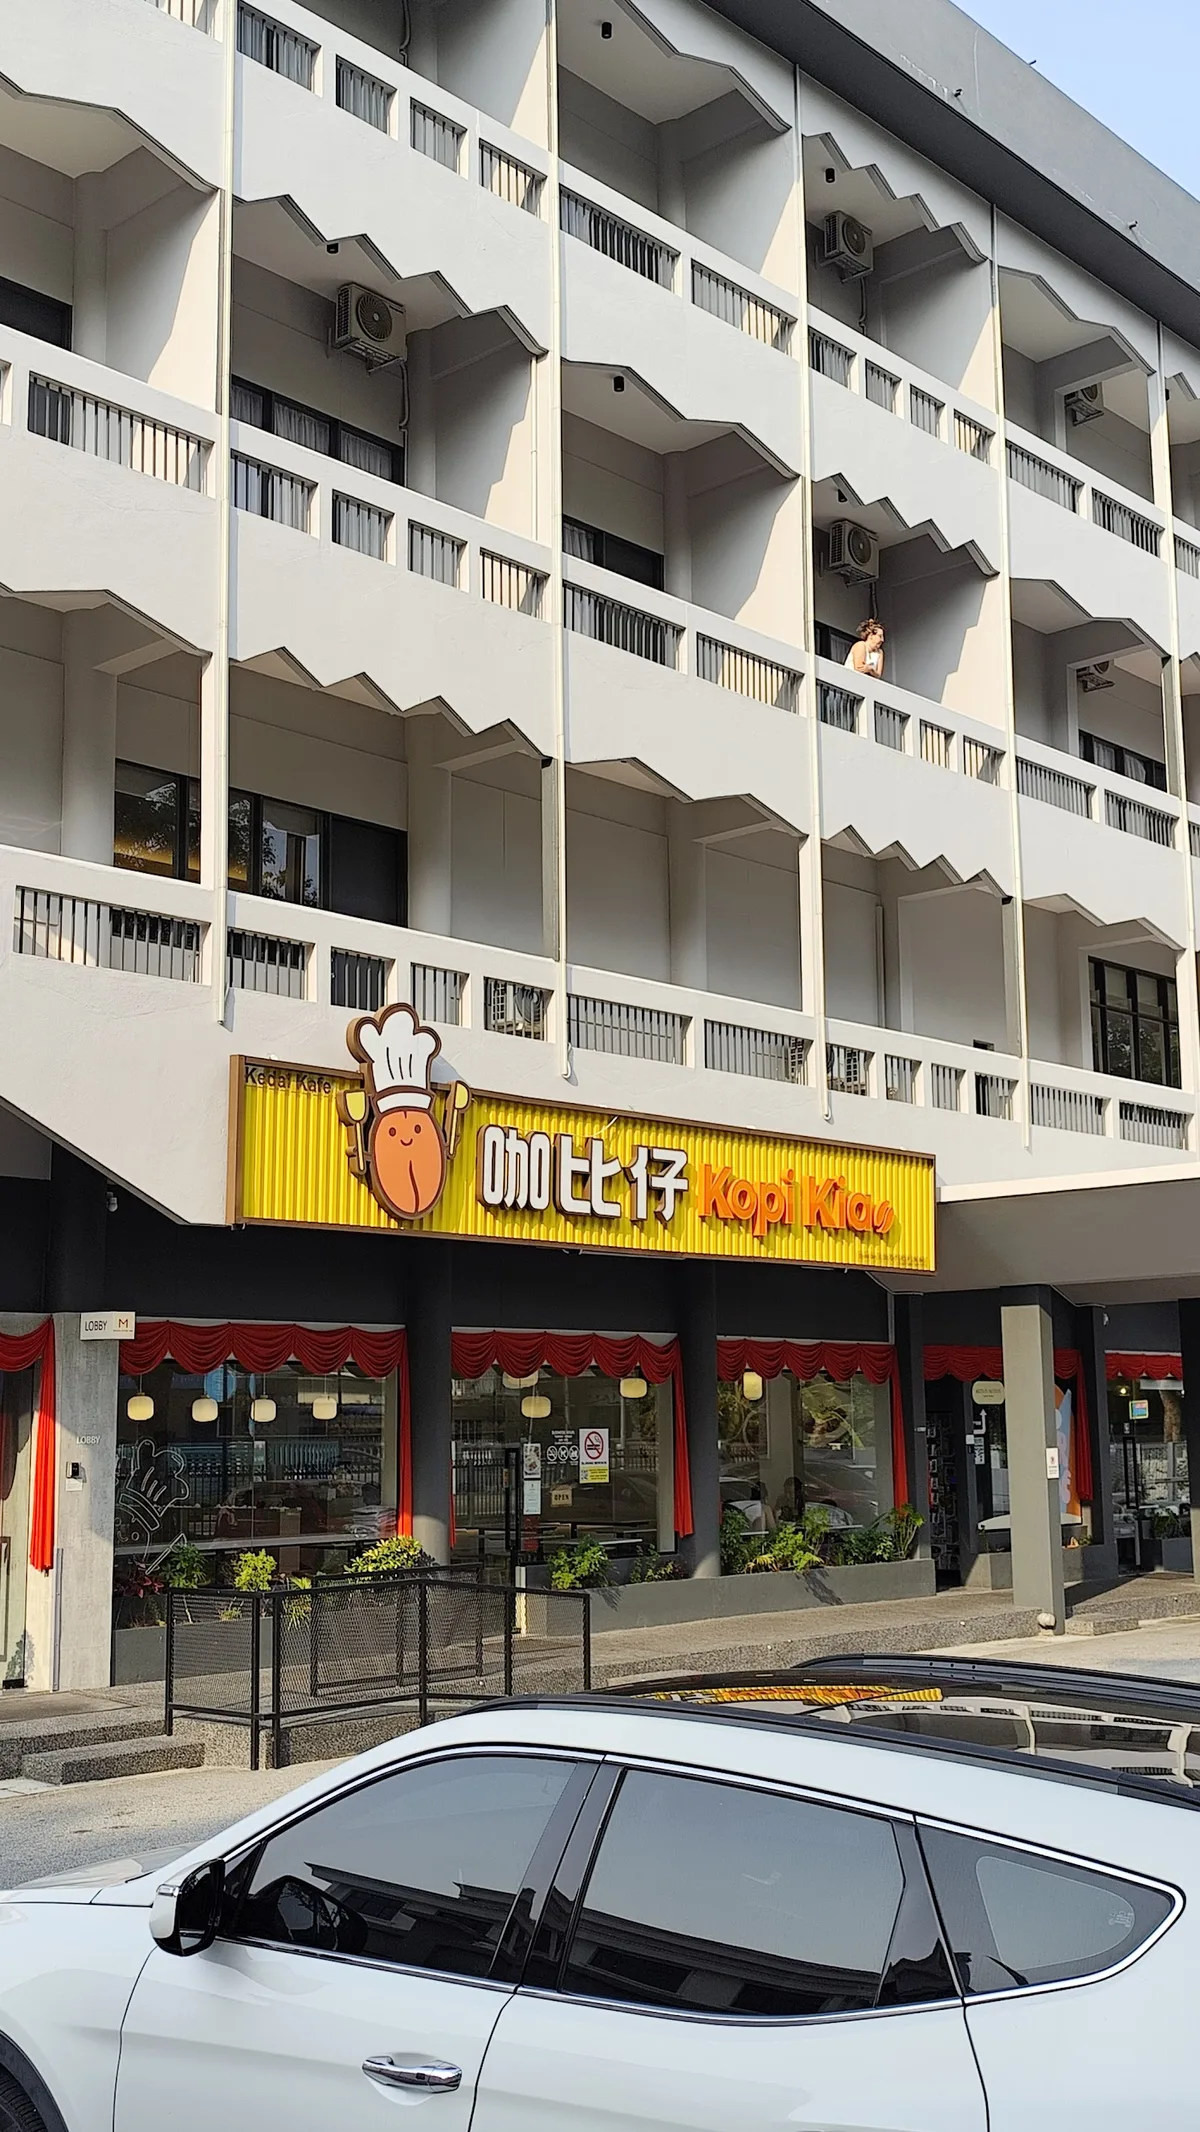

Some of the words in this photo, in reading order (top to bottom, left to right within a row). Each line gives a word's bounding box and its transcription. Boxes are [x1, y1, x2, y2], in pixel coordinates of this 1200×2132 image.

[245, 1067, 291, 1089] Kedai
[296, 1074, 332, 1094] Kafe
[476, 1122, 689, 1226] 咖比仔
[698, 1163, 796, 1237] Kopi
[84, 1320, 108, 1332] LOBBY
[76, 1435, 101, 1445] LOBBY
